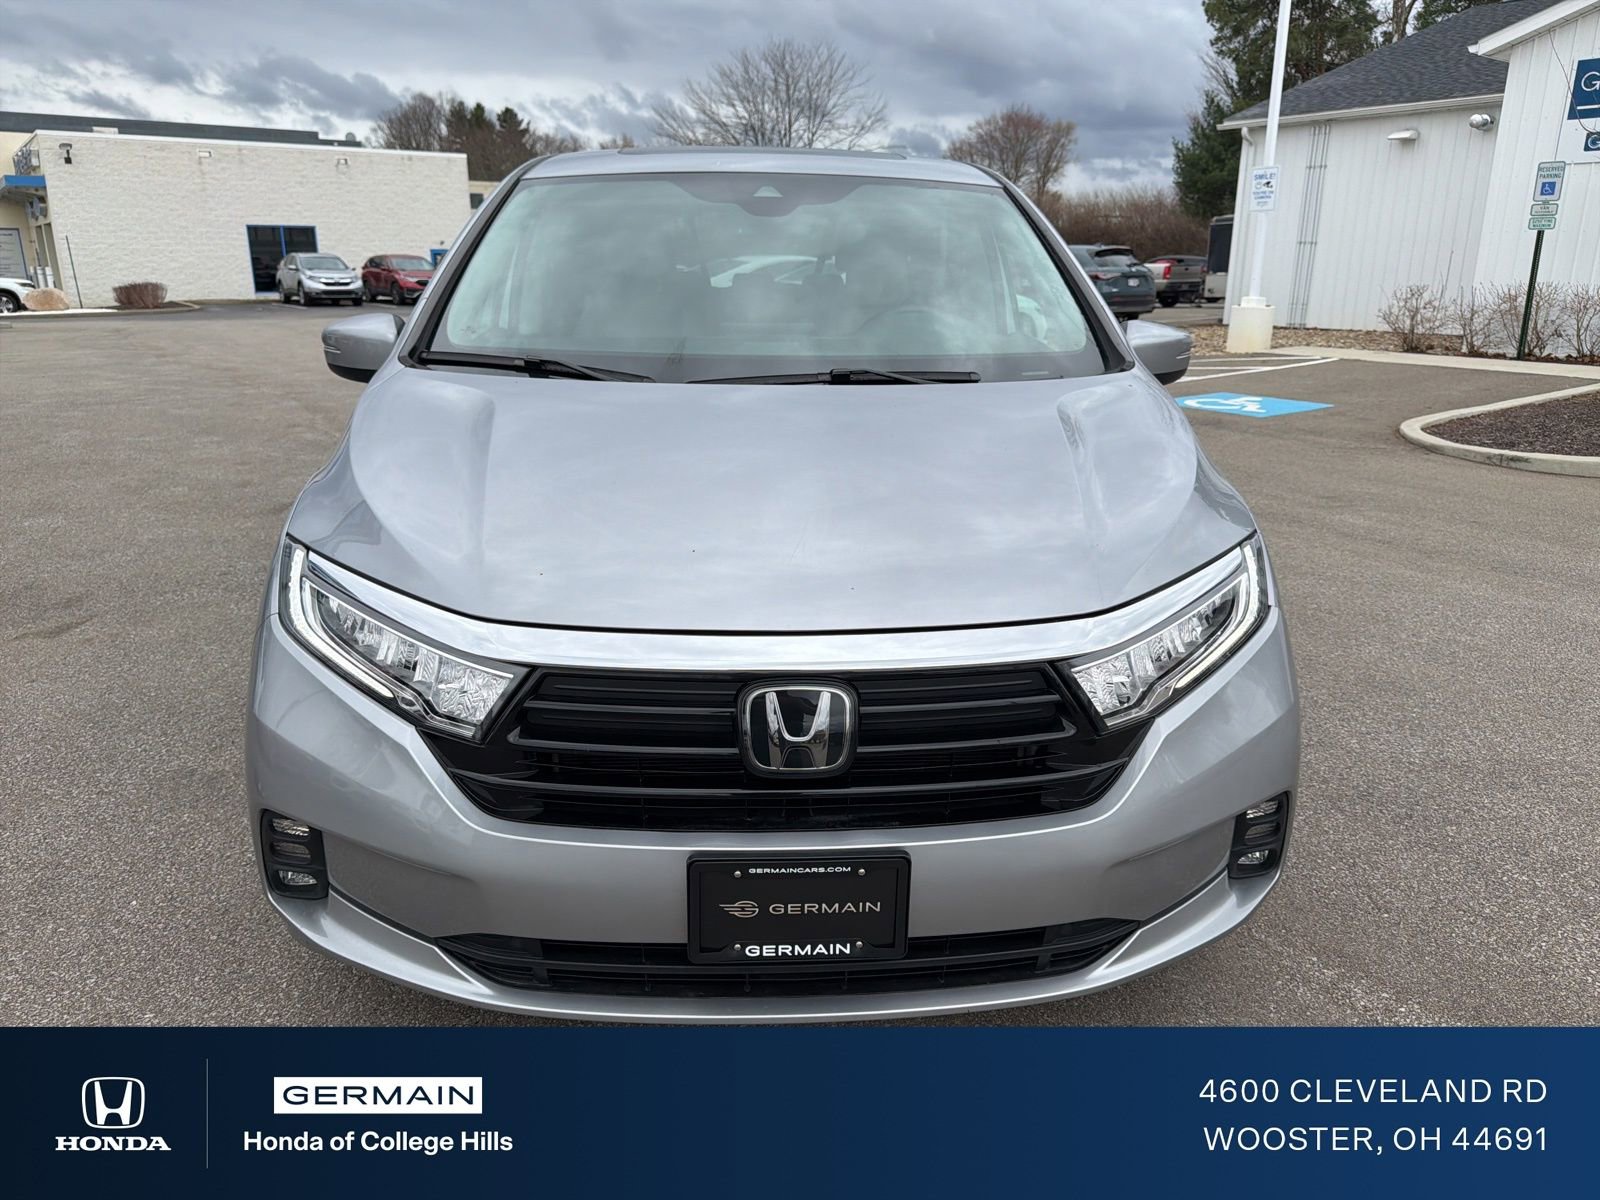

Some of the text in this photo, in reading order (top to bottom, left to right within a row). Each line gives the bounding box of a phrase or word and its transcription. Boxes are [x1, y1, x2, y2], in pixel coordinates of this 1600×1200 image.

[748, 866, 851, 874] GERMAINCARS.COM
[769, 902, 881, 915] GERMAIN
[745, 943, 851, 957] GERMAIN
